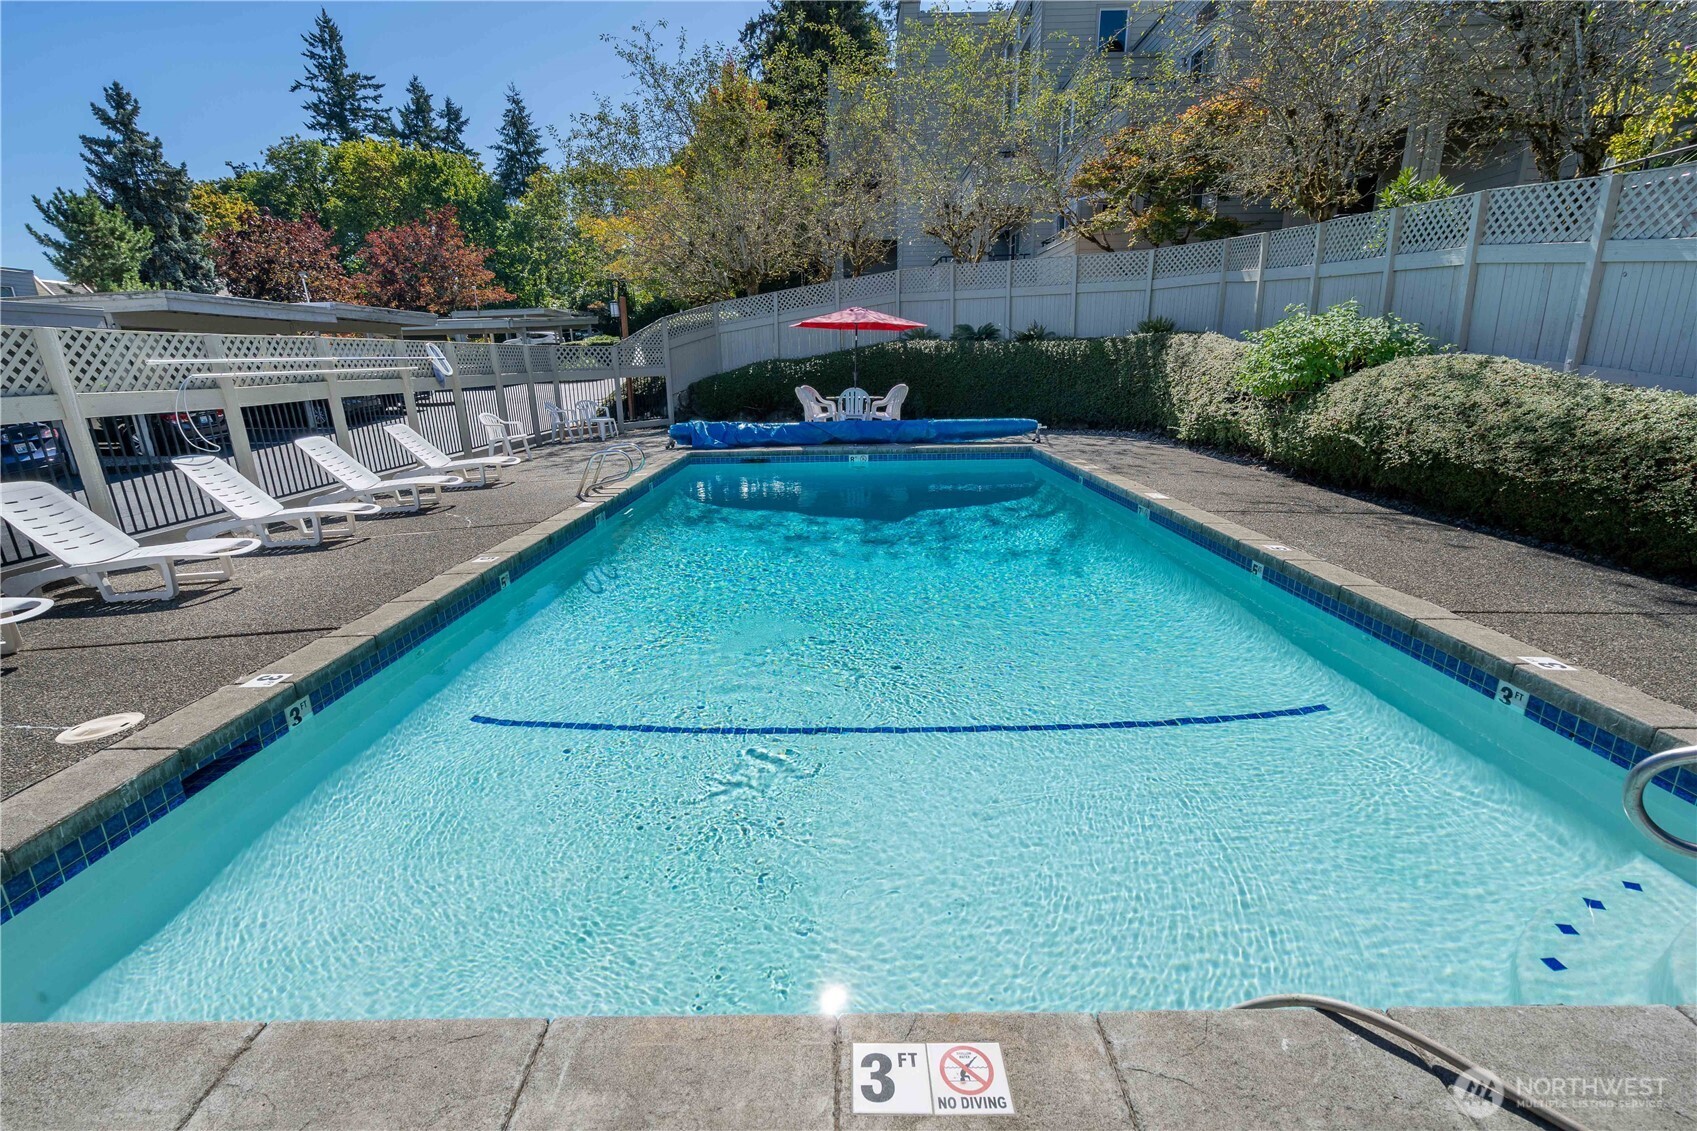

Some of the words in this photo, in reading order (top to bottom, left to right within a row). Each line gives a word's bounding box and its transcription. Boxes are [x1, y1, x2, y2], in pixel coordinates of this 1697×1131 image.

[1252, 564, 1258, 575] 5
[1498, 686, 1514, 706] 3
[1514, 691, 1524, 701] FT
[289, 706, 303, 727] 3
[300, 700, 308, 710] FT
[860, 1052, 896, 1103] 3
[897, 1052, 918, 1068] FT
[938, 1096, 957, 1110] NO
[961, 1096, 1008, 1110] DIVING
